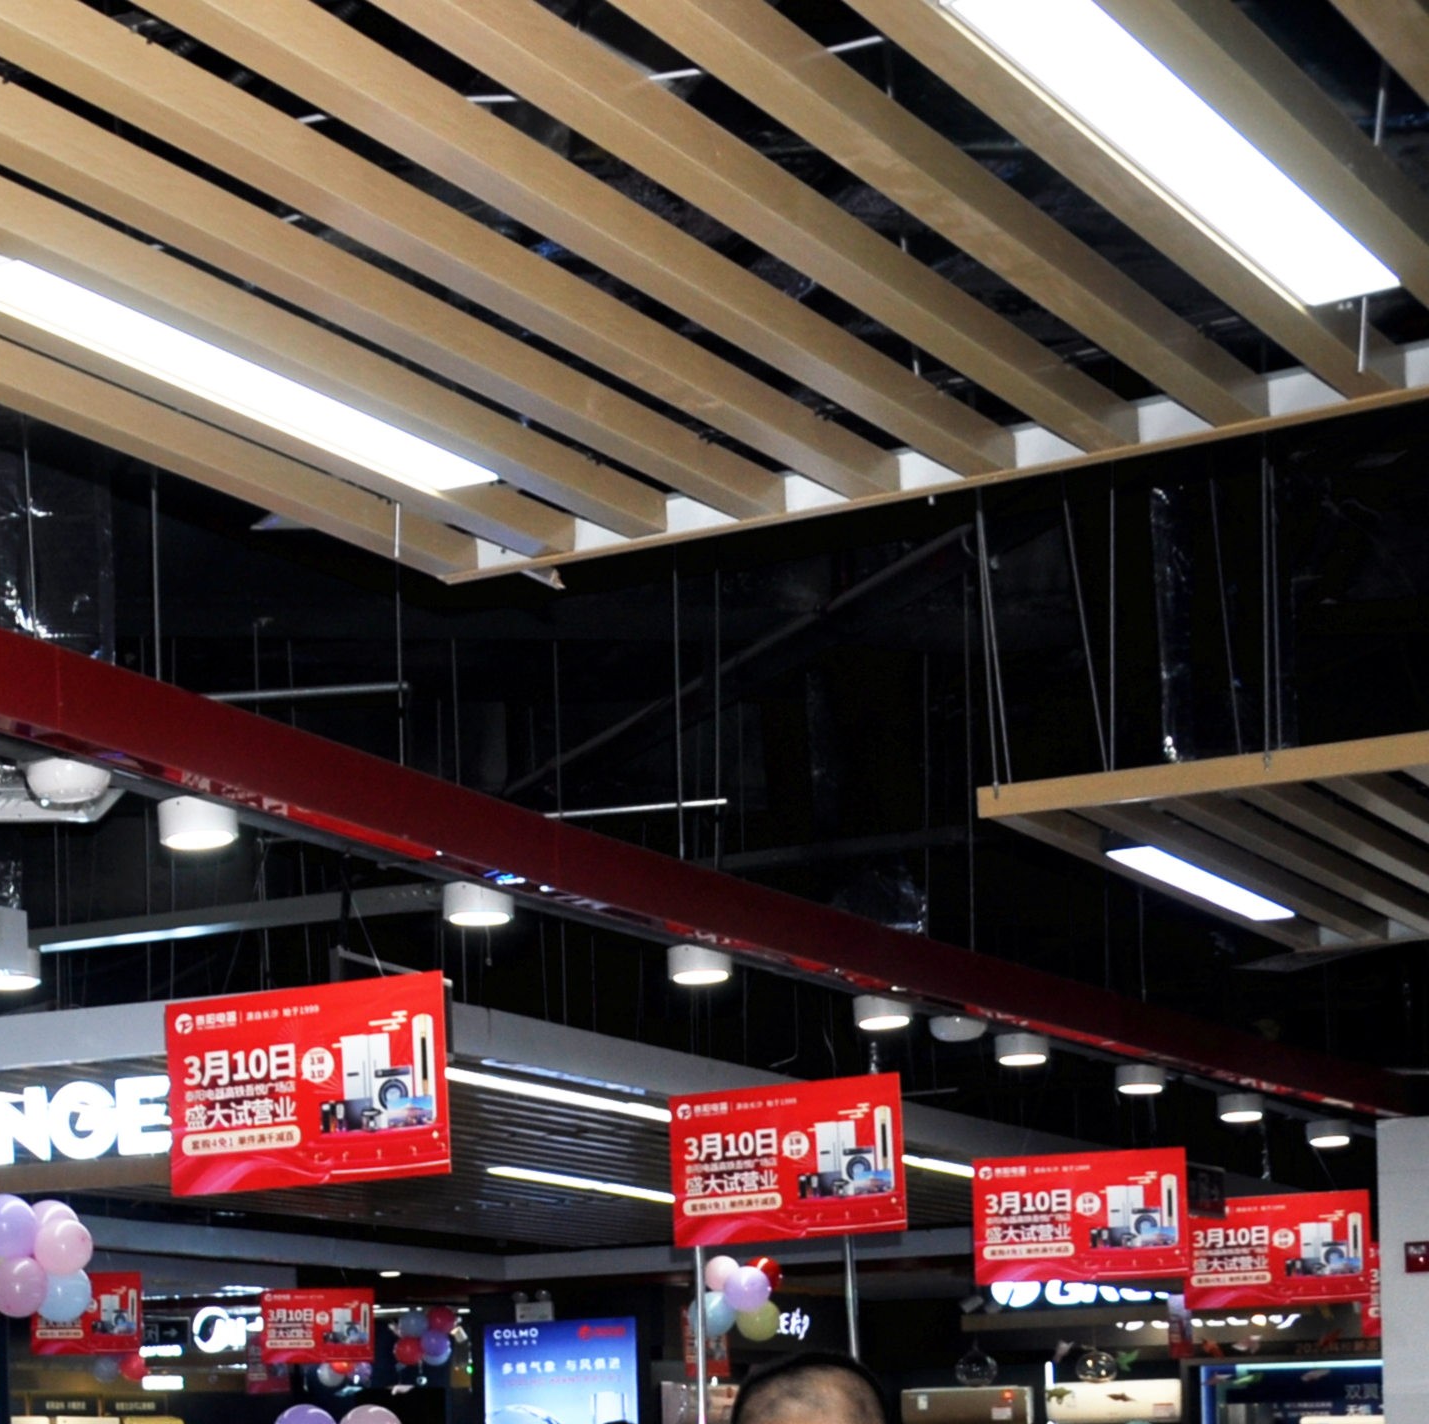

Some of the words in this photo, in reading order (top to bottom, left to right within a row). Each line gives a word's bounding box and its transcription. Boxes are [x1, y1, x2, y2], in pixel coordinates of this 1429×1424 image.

[184, 1043, 297, 1087] 3月10日
[185, 1096, 297, 1132] 盛大试营业
[684, 1127, 778, 1162] 3月10日
[684, 1170, 779, 1198] 盛大试营业
[984, 1188, 1072, 1215] 3月10日
[985, 1223, 1072, 1244] 盛大试营业
[1192, 1225, 1270, 1248] 3月10日
[267, 1307, 315, 1323] 3月10日
[493, 1327, 539, 1340] COLMO
